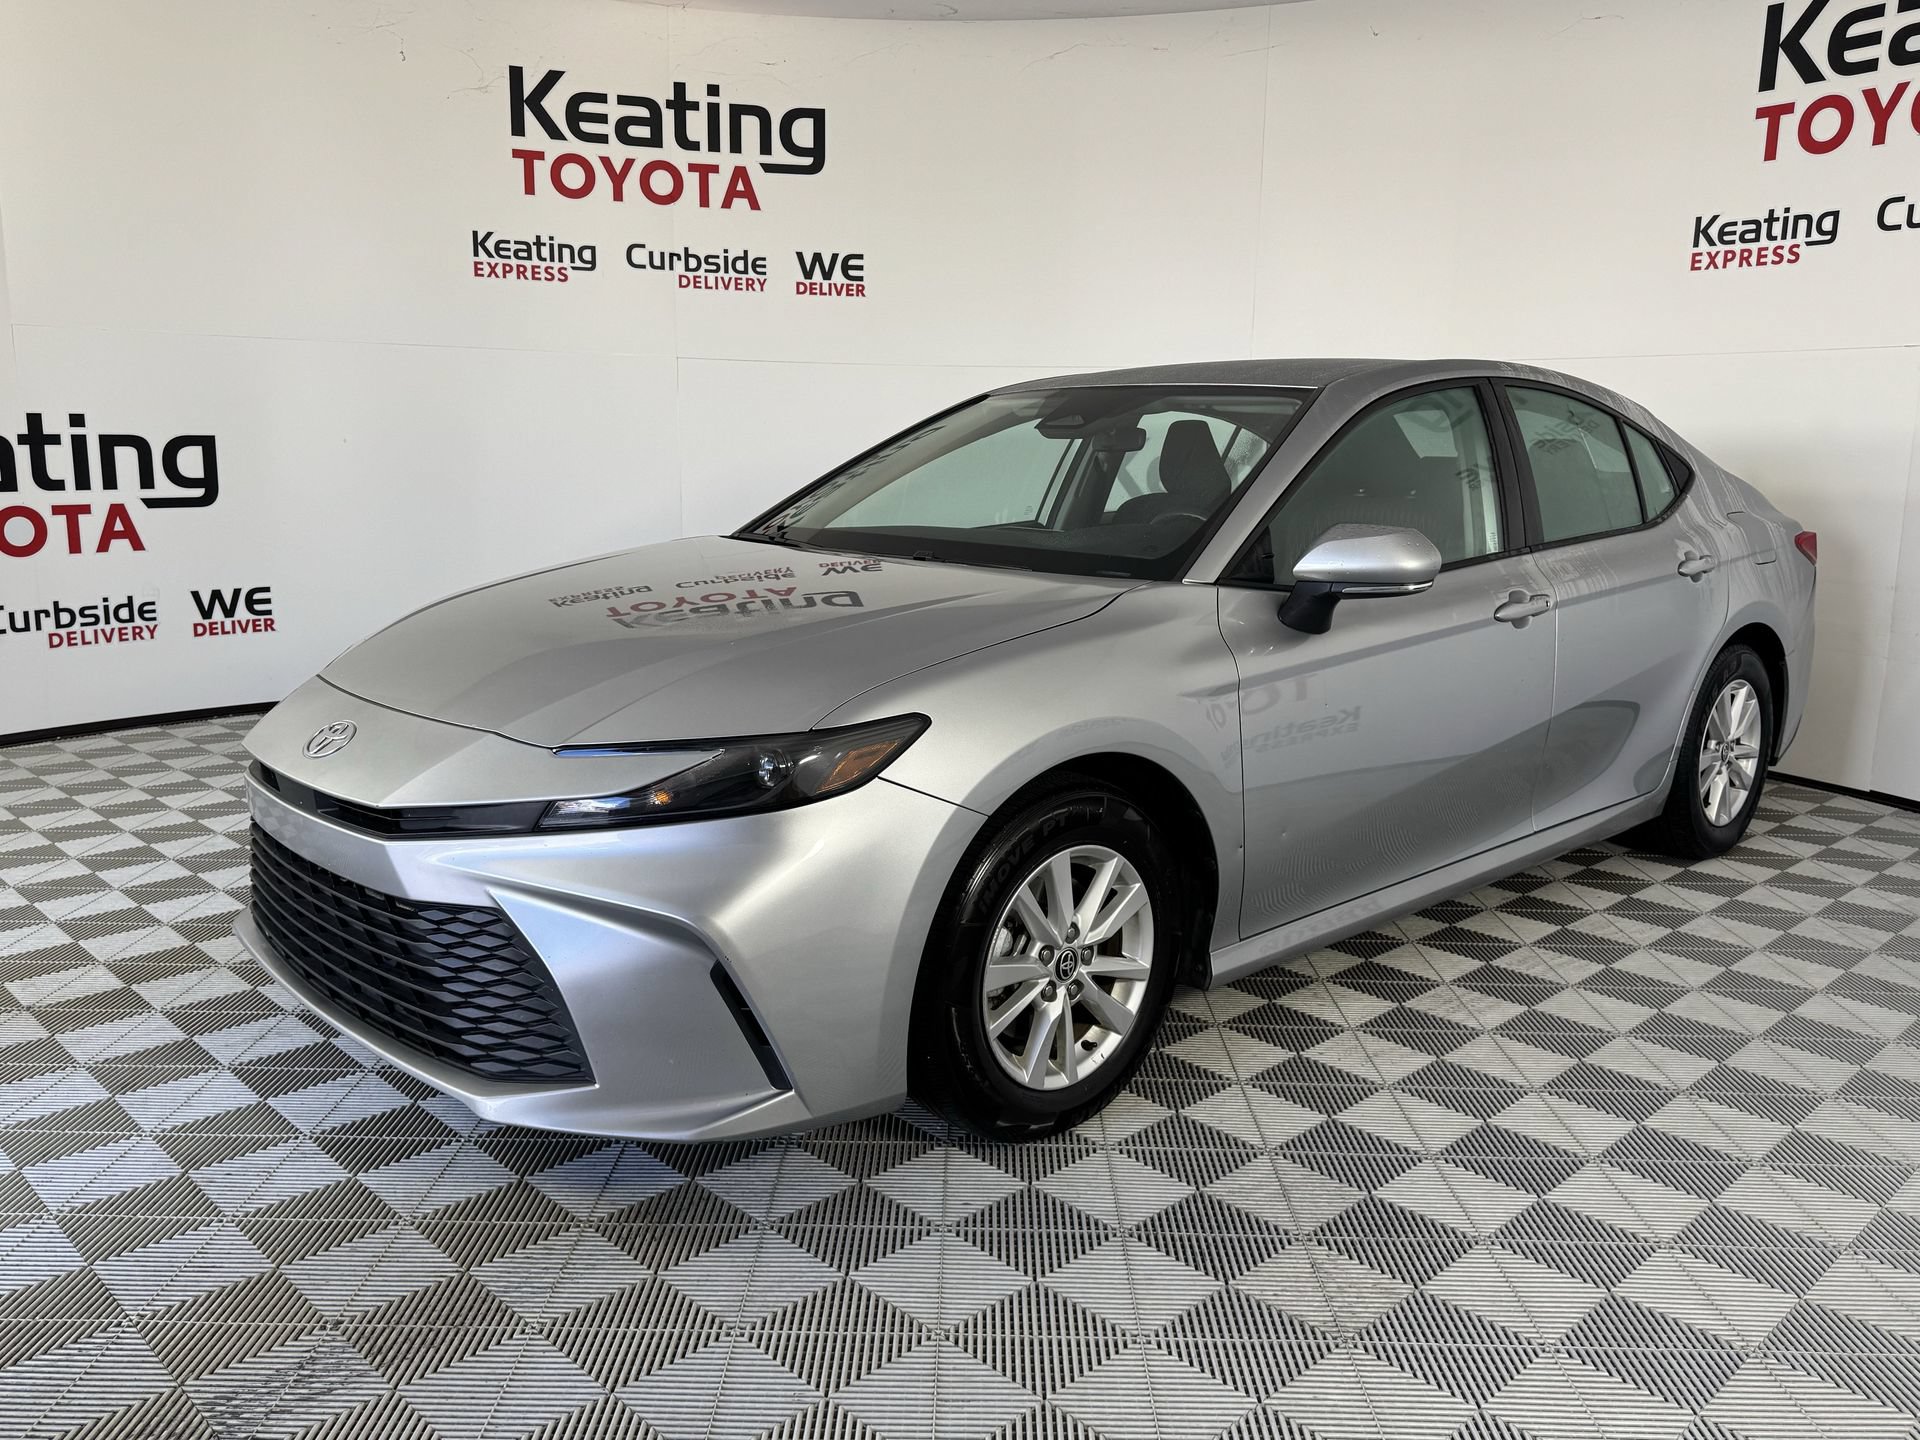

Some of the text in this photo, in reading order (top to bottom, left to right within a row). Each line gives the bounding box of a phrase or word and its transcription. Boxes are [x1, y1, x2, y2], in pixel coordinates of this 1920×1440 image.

[509, 65, 825, 175] Keating
[1756, 80, 1920, 162] TOY
[512, 148, 761, 211] TOYOTA
[1692, 206, 1841, 248] Keating
[472, 230, 597, 271] Keating
[626, 243, 767, 276] Curbside
[795, 251, 865, 282] WE
[1690, 243, 1801, 271] EXPRESS
[473, 260, 570, 283] EXPRESS
[678, 275, 768, 292] DELIVERY
[795, 280, 866, 298] DELIVER
[0, 595, 158, 634] urbside
[190, 586, 273, 620] WE
[48, 624, 159, 649] DELIVERY
[193, 617, 276, 637] DELIVER
